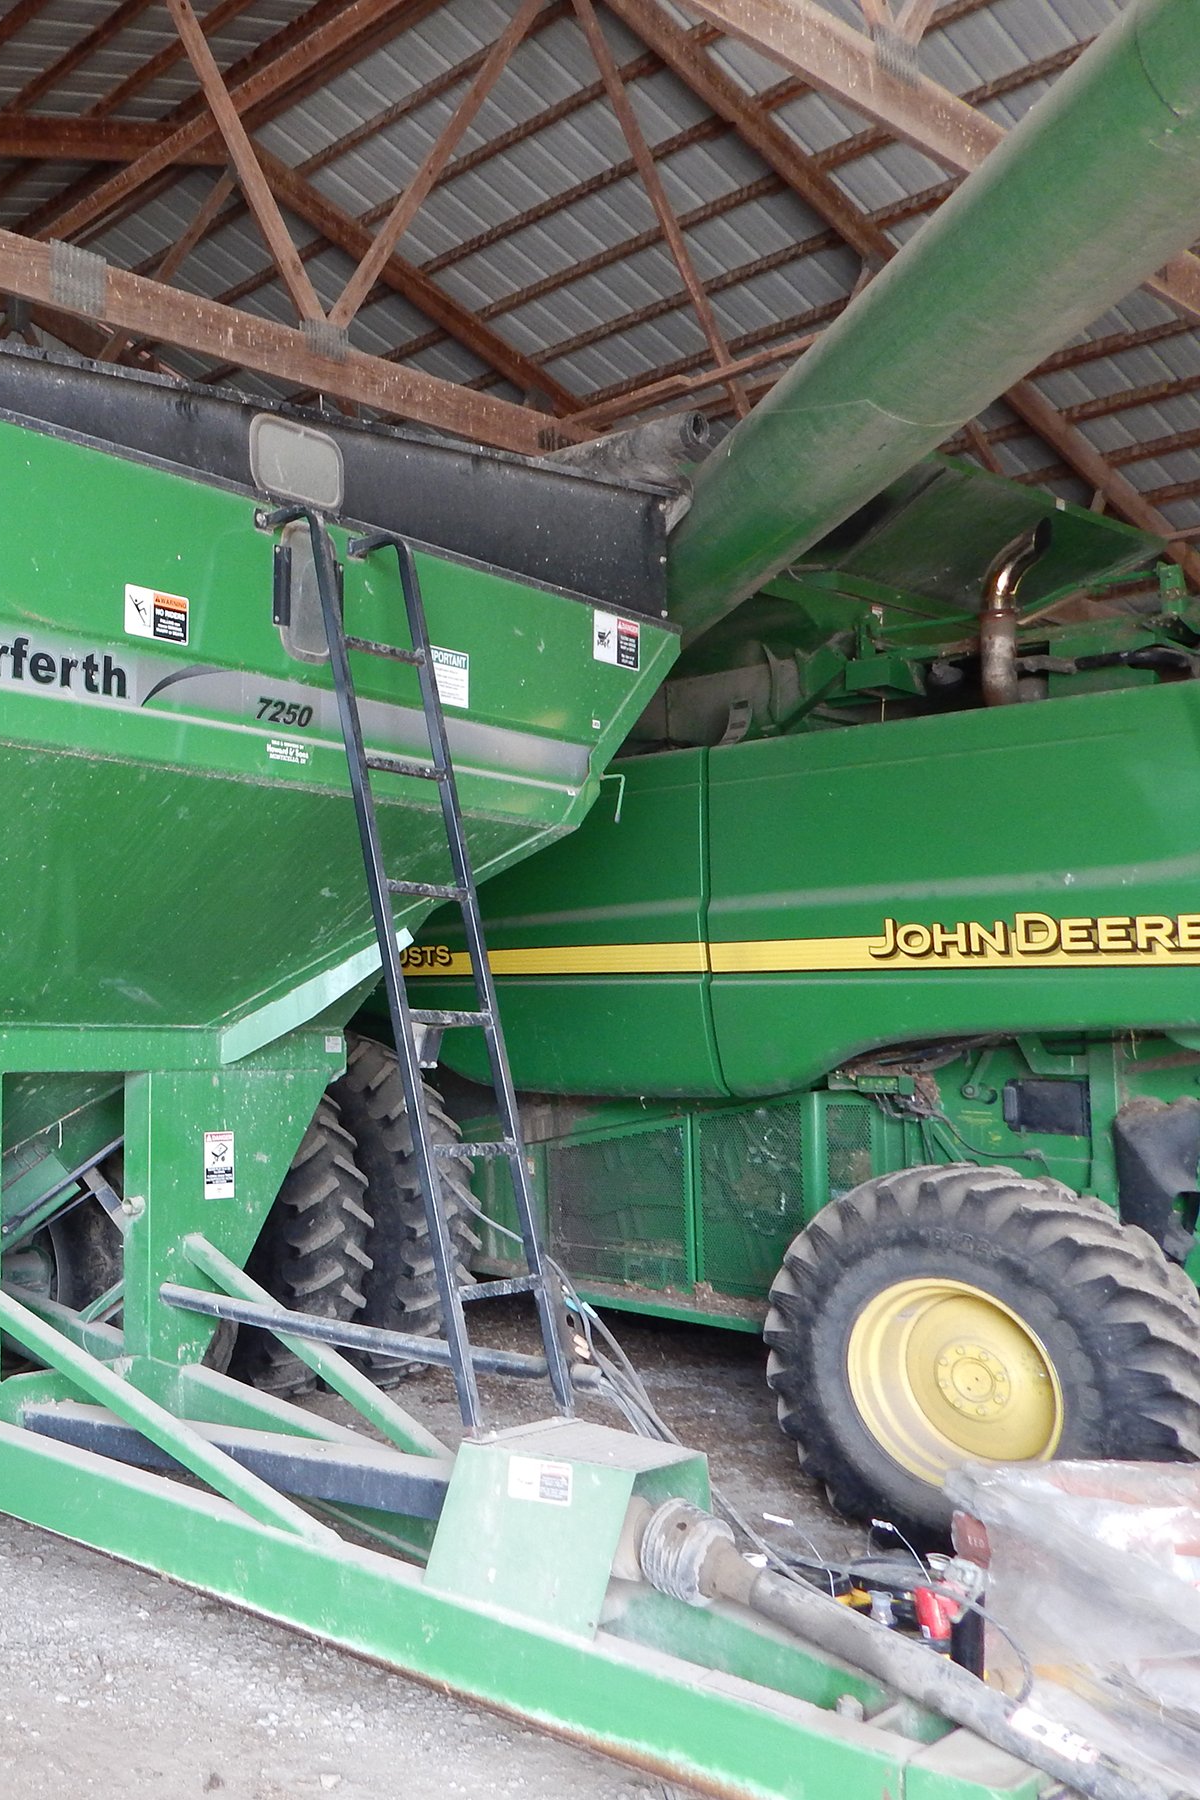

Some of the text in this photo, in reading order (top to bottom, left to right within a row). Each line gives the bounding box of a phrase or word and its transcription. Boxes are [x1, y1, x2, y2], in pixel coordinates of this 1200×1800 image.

[160, 598, 186, 609] WARNING
[256, 697, 314, 728] 7250
[868, 917, 1008, 958] JOHN
